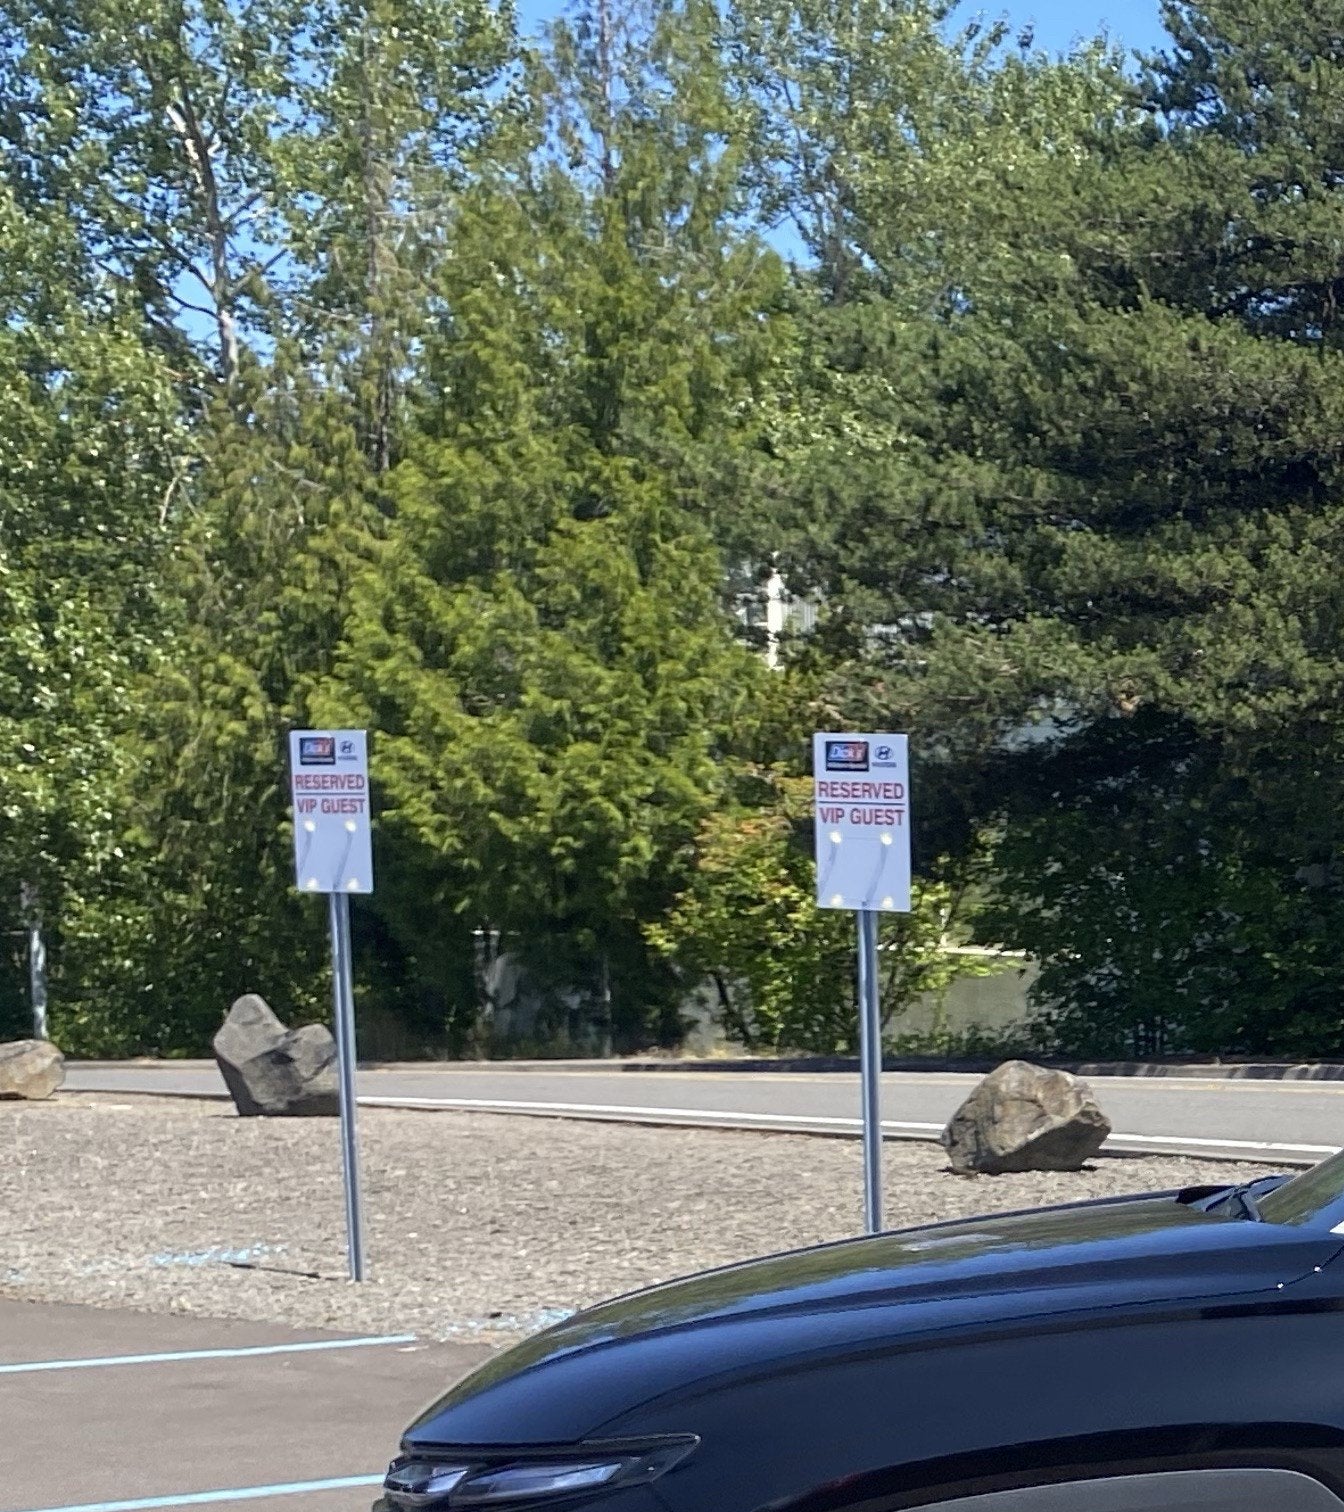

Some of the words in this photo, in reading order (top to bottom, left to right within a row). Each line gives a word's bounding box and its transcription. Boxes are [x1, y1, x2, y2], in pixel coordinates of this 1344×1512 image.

[295, 774, 365, 790] RESERVED
[818, 781, 904, 800] RESERVED
[296, 798, 317, 814] VIP
[321, 798, 366, 814] GUEST
[819, 807, 845, 824] VIP
[850, 808, 905, 826] GUEST
